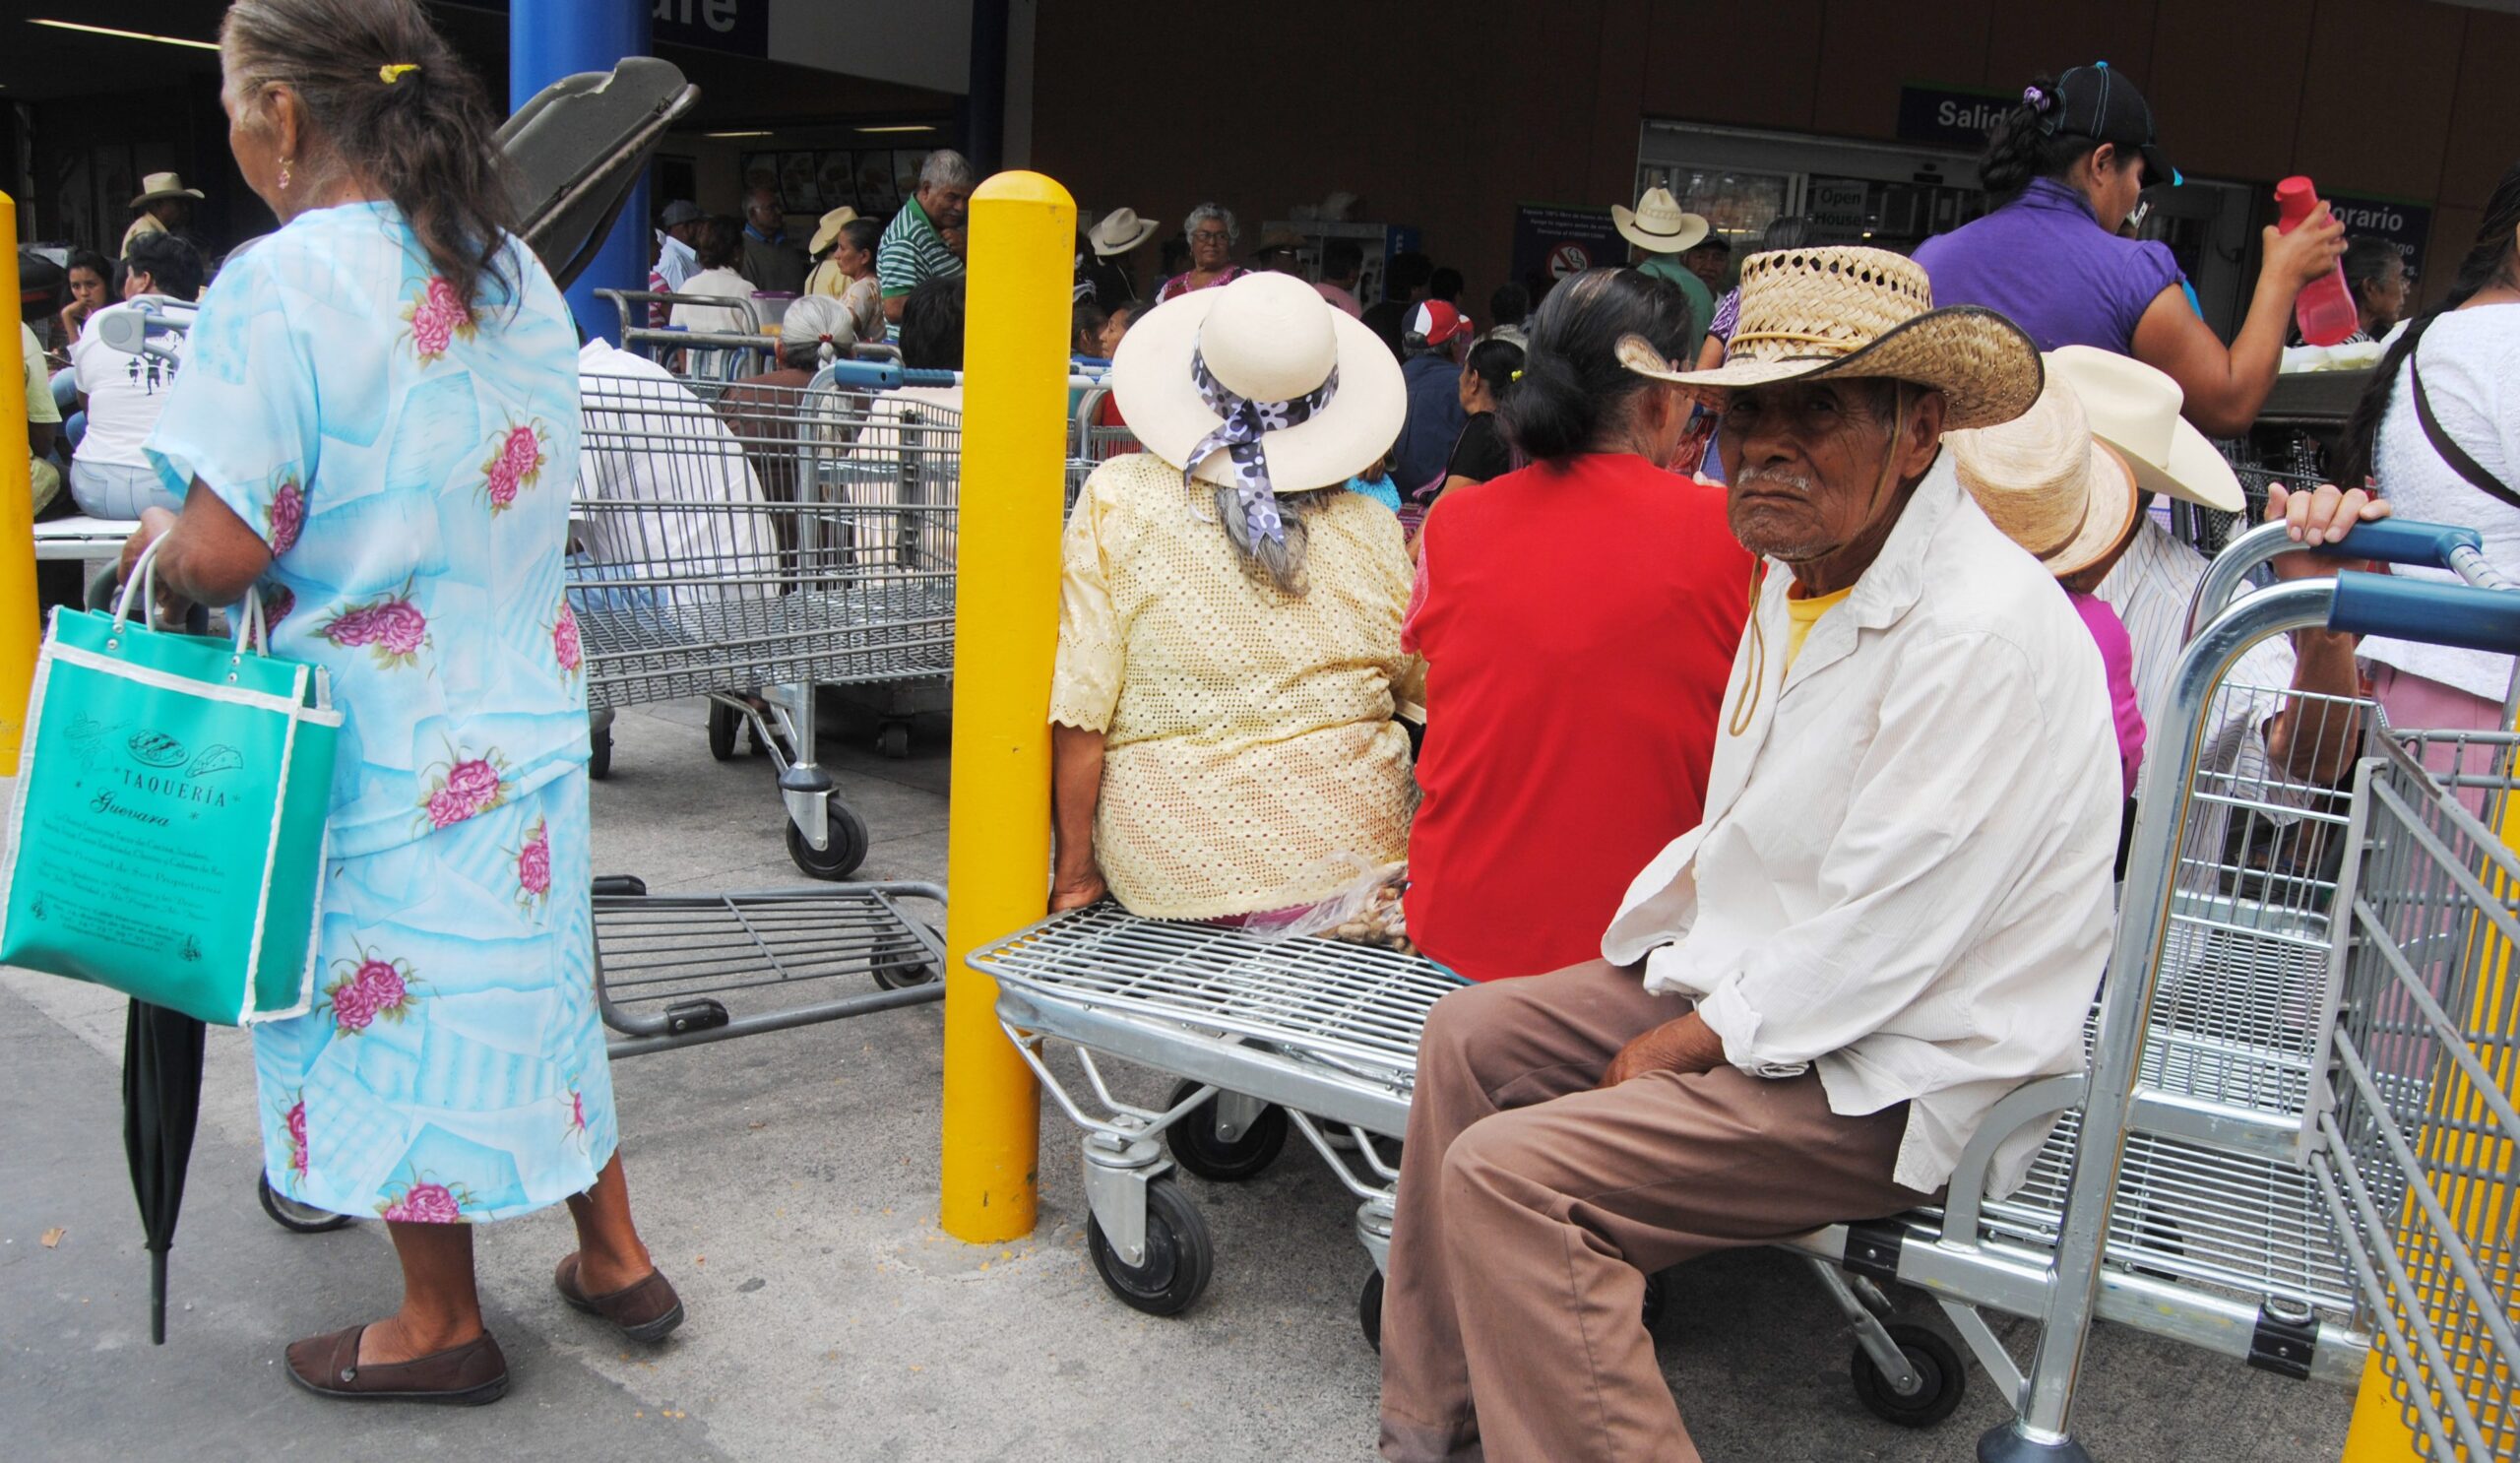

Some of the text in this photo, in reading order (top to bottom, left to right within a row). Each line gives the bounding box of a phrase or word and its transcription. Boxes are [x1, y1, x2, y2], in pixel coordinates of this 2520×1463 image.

[1938, 100, 2007, 129] Salid
[1821, 189, 1860, 206] Open
[1814, 212, 1861, 226] House
[2331, 206, 2403, 232] orario
[123, 769, 225, 807] TAQUERÍA
[89, 787, 170, 827] Guevara
